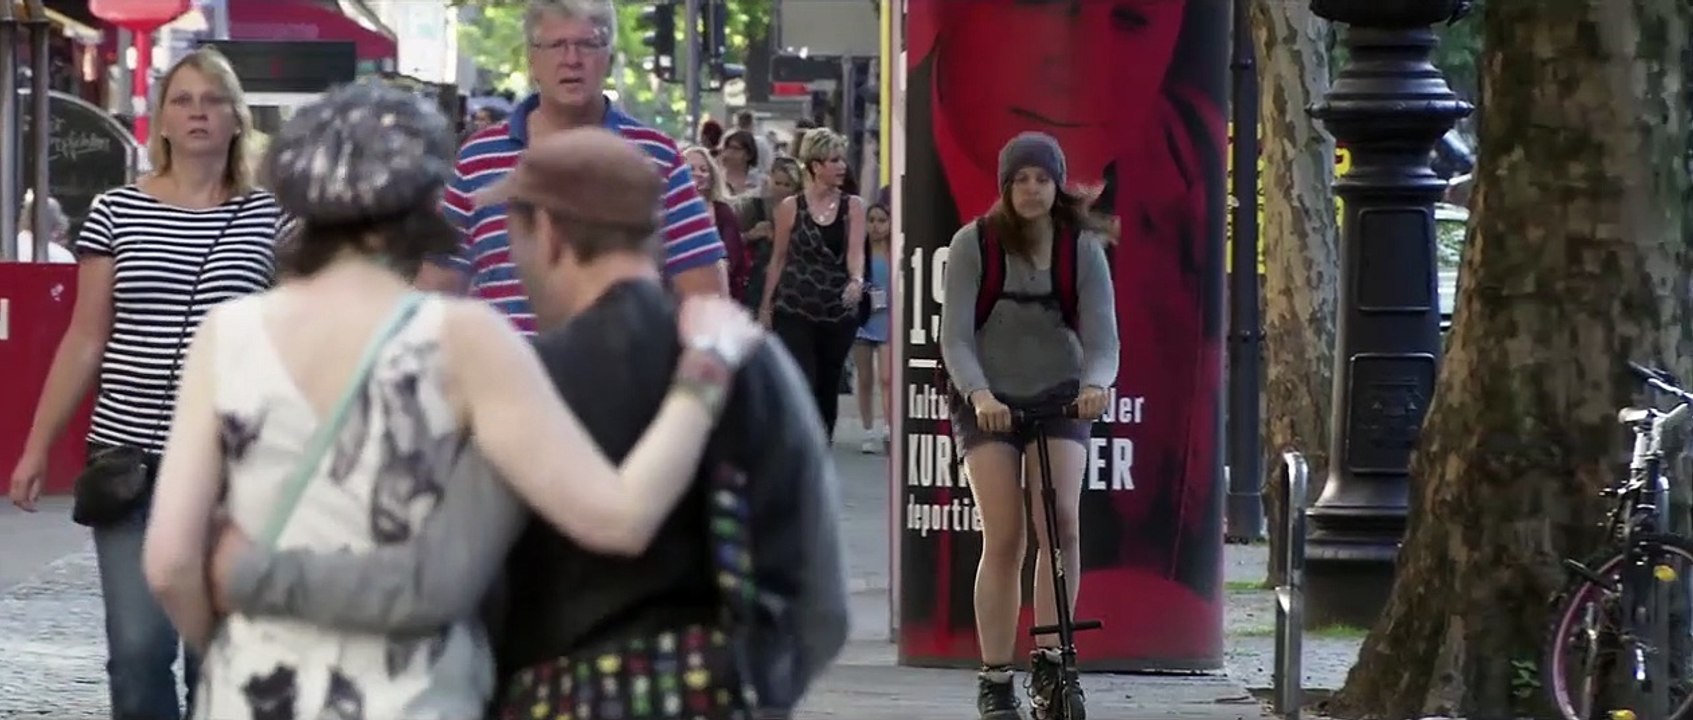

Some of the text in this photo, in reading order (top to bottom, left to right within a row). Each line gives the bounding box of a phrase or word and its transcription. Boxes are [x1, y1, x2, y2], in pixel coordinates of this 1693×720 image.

[909, 247, 949, 344] 19
[908, 384, 1144, 423] Kultu der
[1088, 438, 1135, 490] ER
[907, 494, 982, 537] deportie
